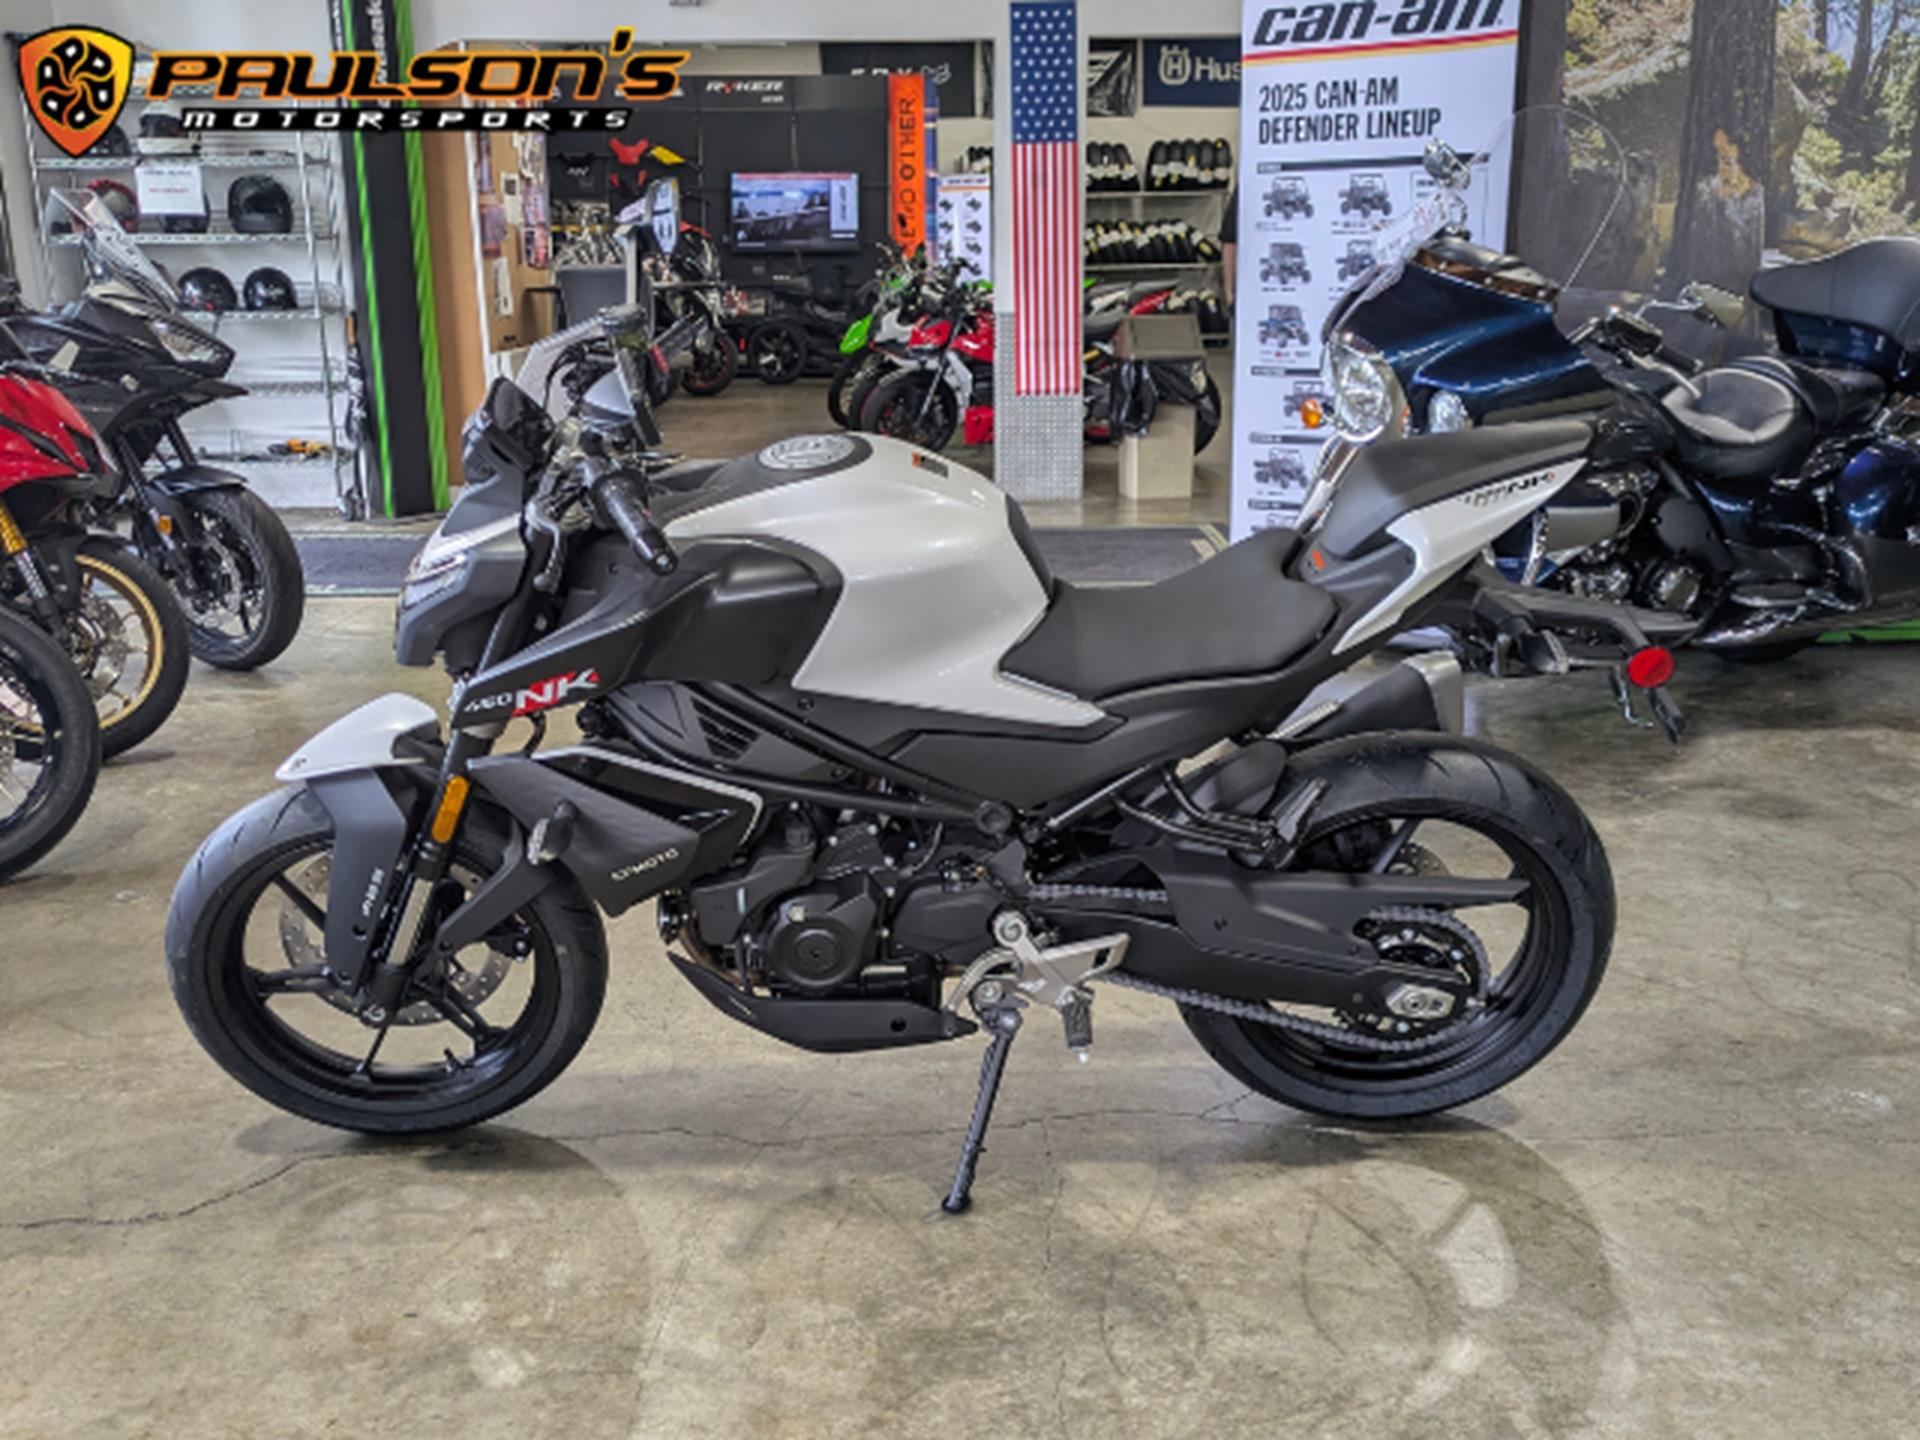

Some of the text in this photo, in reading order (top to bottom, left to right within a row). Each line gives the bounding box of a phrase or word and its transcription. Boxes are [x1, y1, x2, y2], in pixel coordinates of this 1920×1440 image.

[1259, 77, 1399, 112] 2025 CAN-AM
[898, 98, 916, 181] OTHER
[1259, 108, 1442, 145] DEFENDER LINEUP
[515, 668, 598, 709] NK
